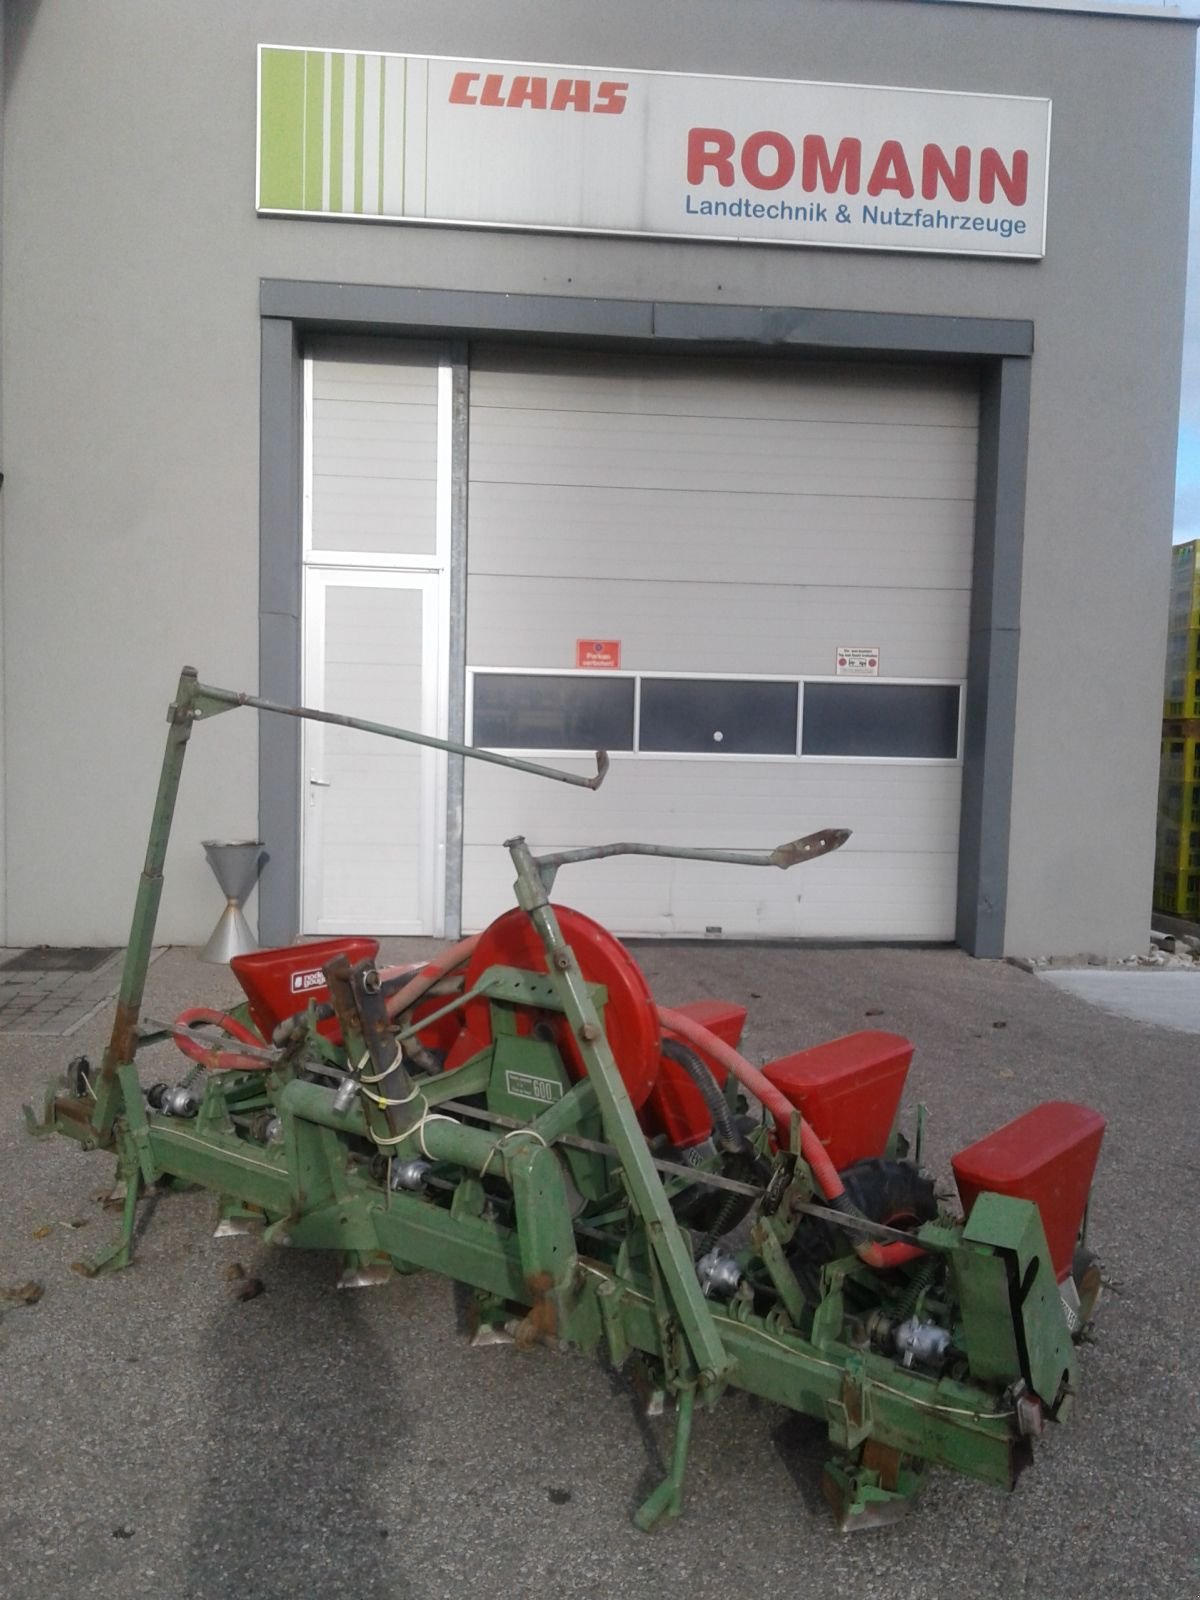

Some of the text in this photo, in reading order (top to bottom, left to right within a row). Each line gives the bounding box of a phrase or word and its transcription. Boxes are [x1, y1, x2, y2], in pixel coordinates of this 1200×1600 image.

[448, 72, 628, 114] CLAAS
[687, 127, 1028, 206] ROMANN
[685, 195, 1027, 237] Landtechnik & Nutzfahrzeuge
[533, 1080, 553, 1100] 600
